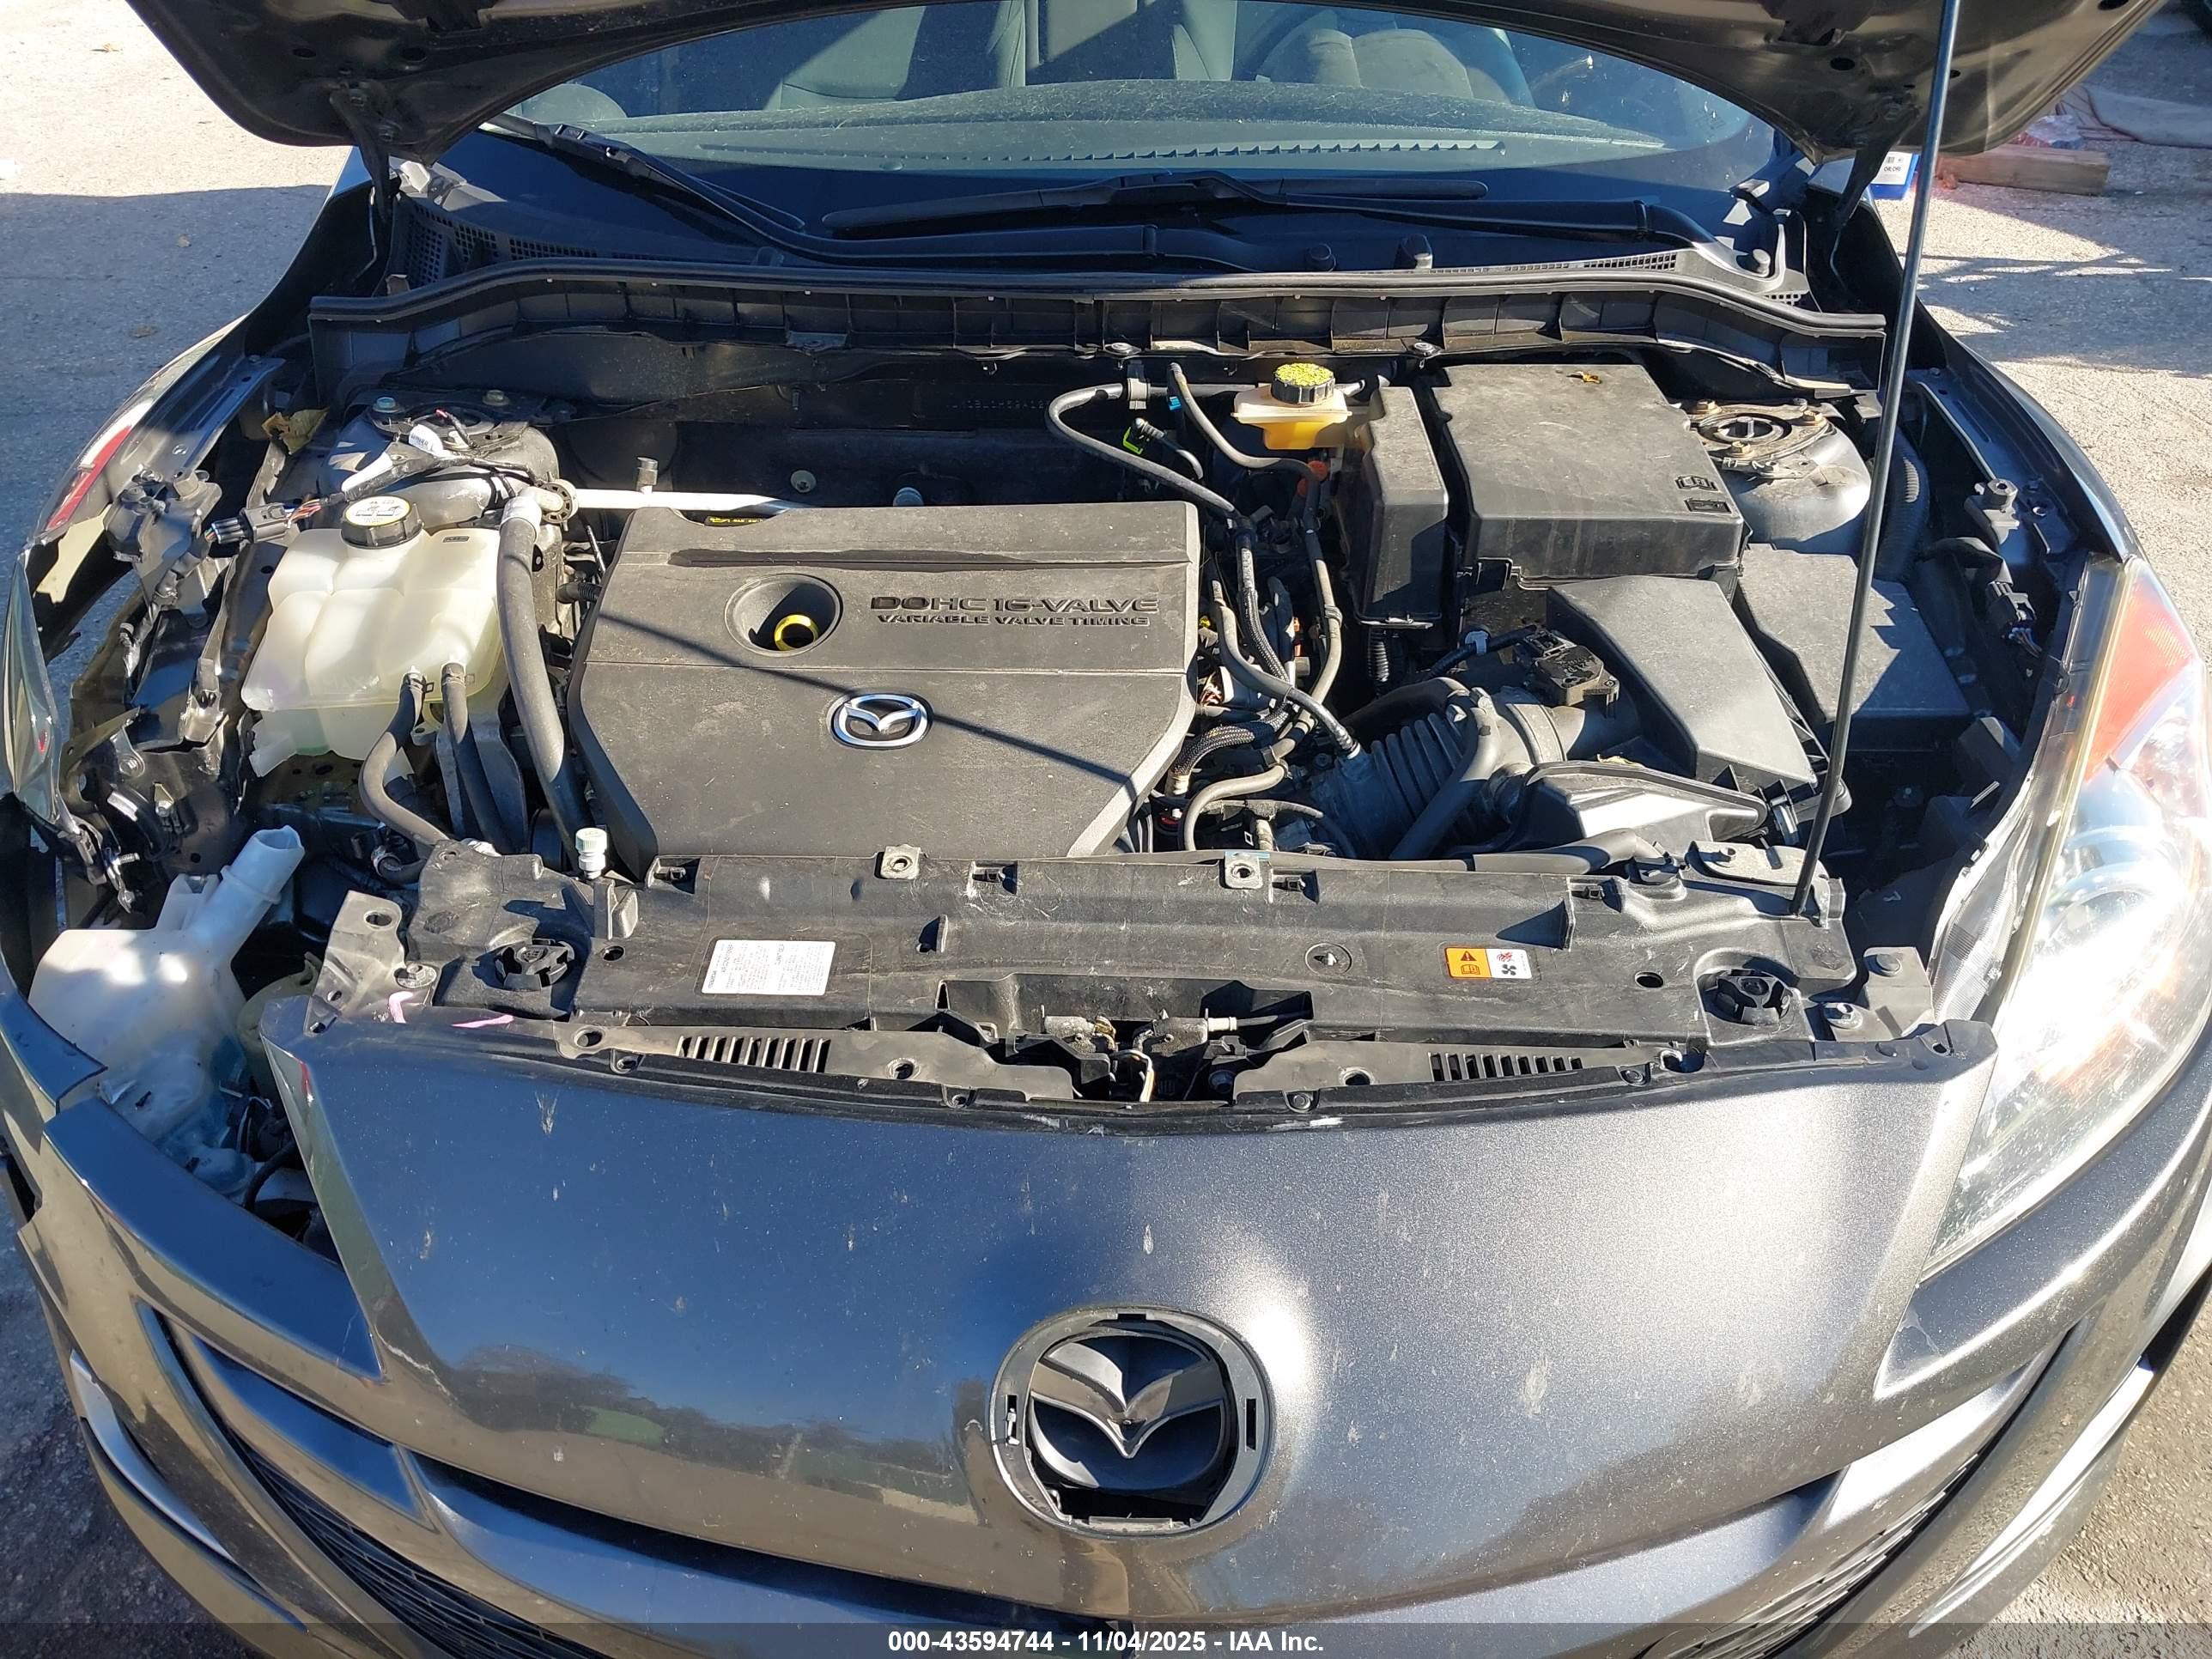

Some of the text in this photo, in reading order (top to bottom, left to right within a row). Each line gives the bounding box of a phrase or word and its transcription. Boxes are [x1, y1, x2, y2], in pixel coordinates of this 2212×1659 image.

[870, 597, 1160, 613] DOHC 16-VALVE
[877, 615, 1150, 626] VARIABLE VALVE TIMING
